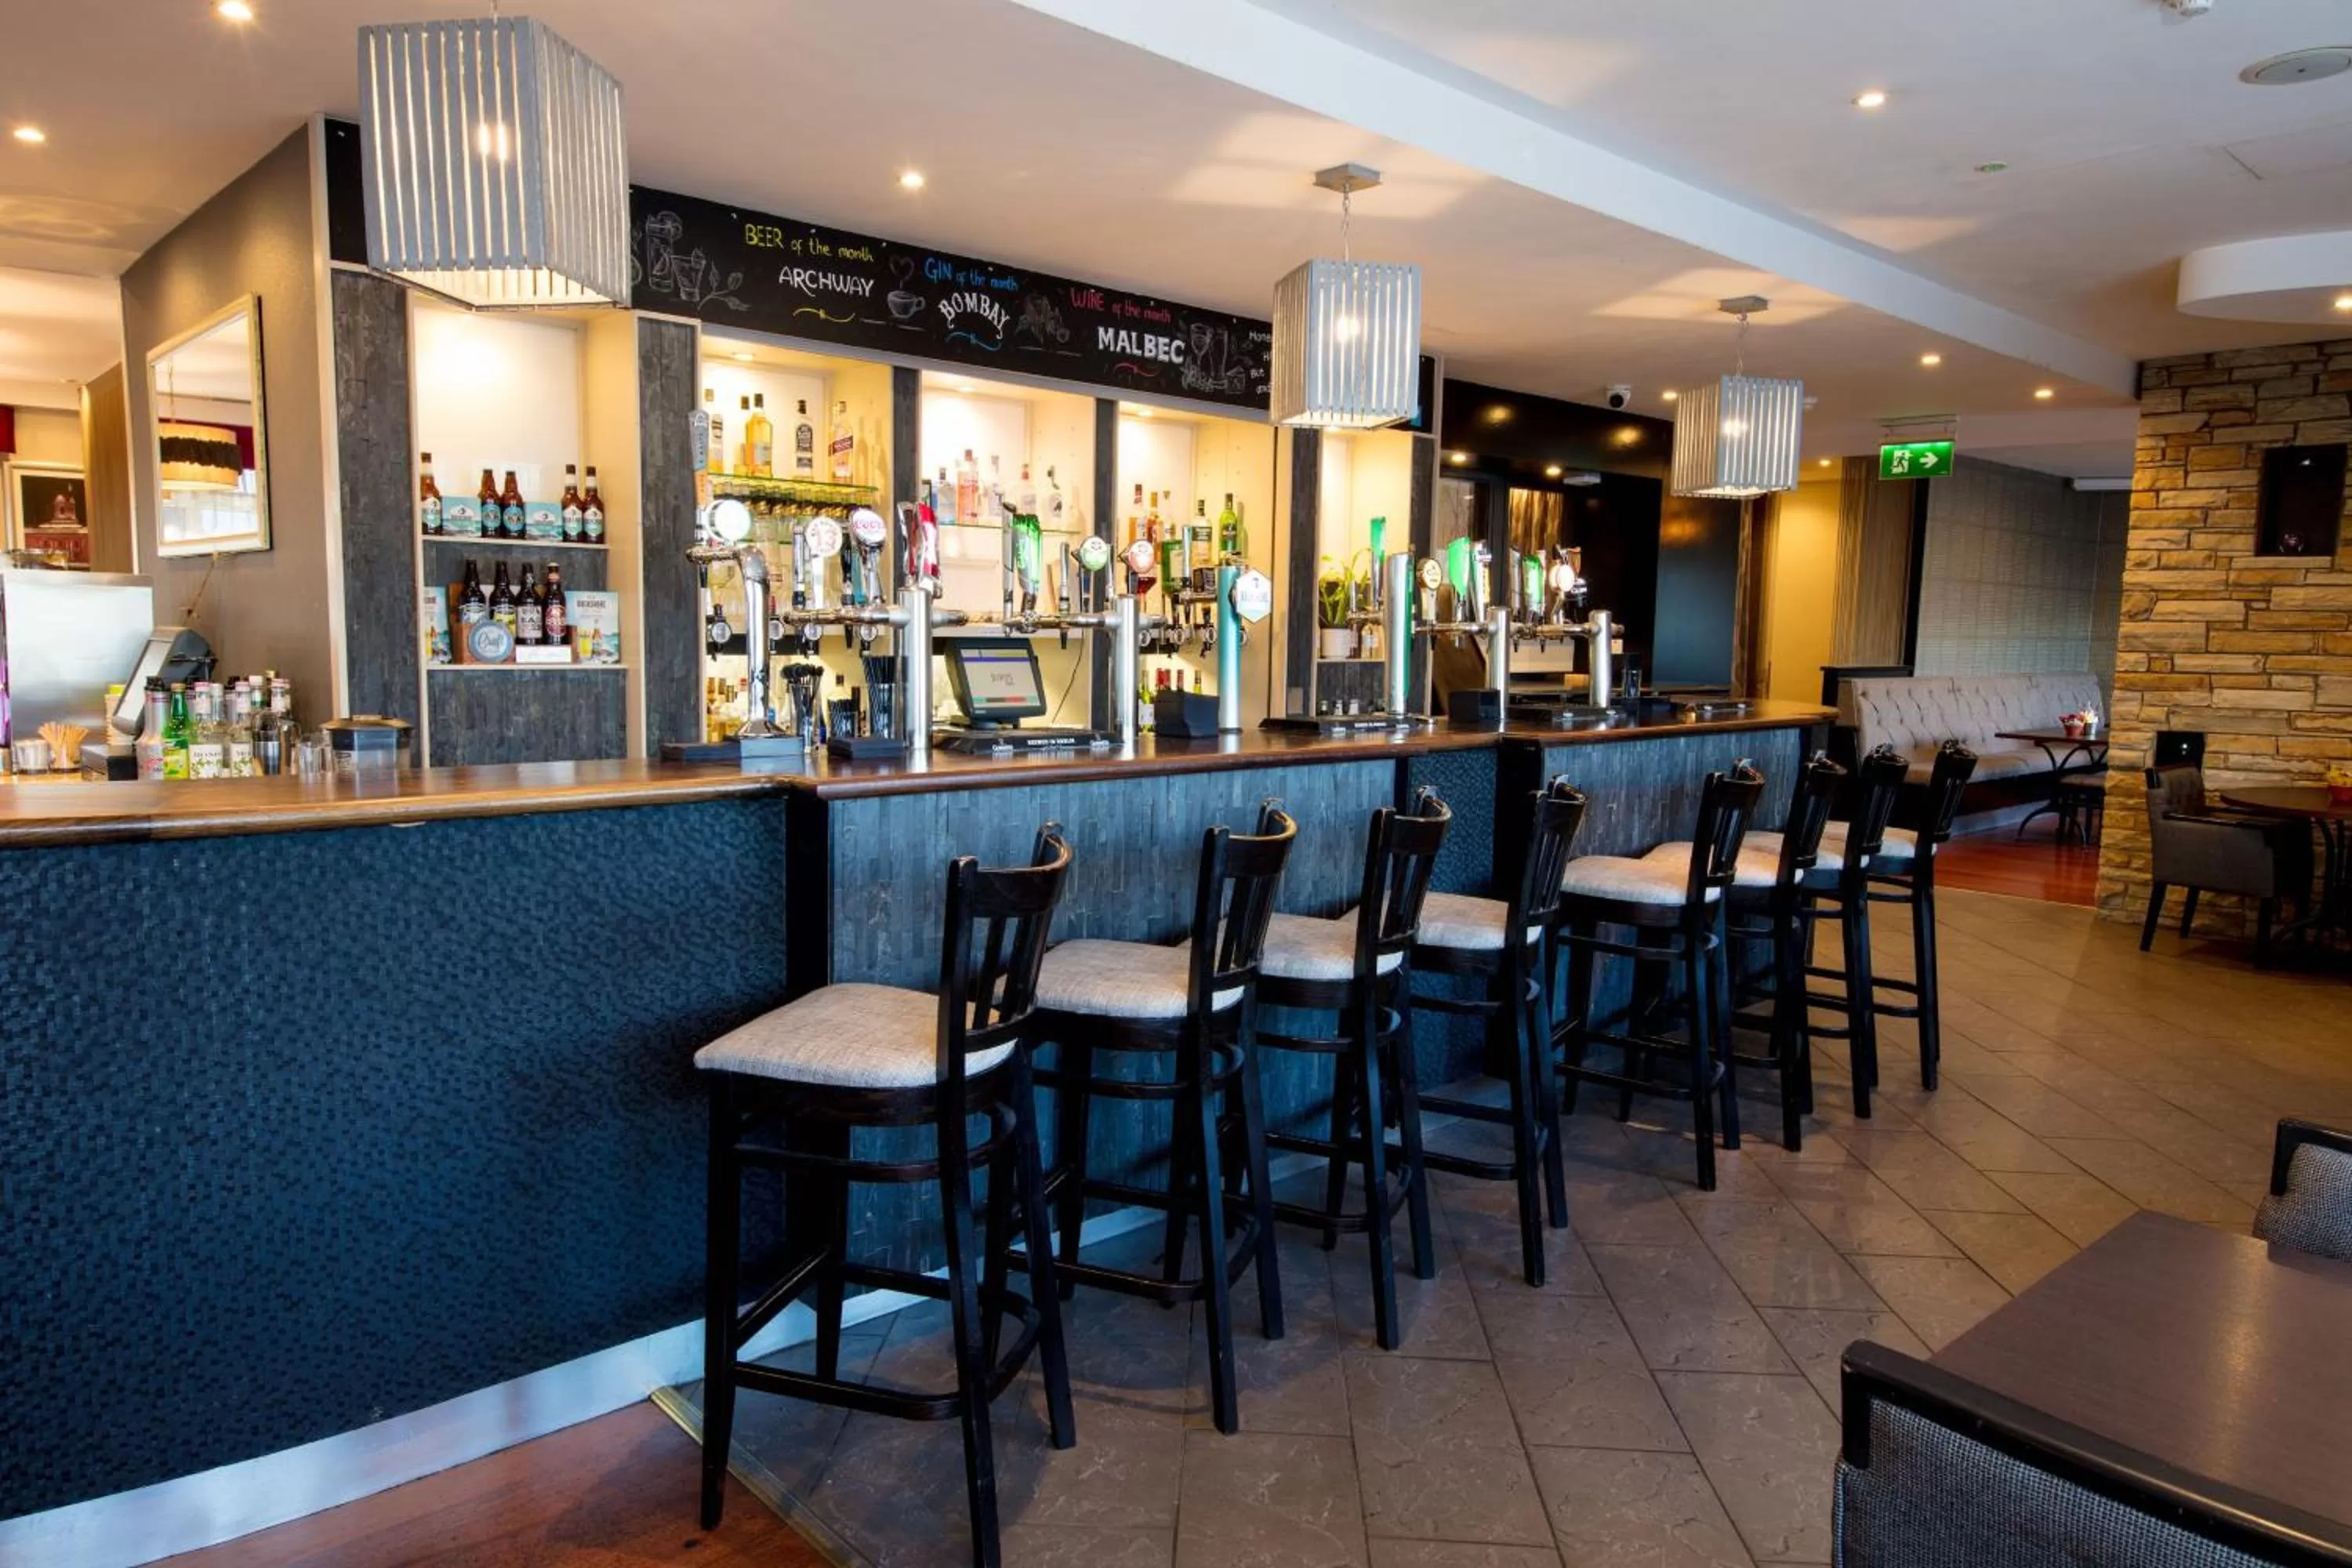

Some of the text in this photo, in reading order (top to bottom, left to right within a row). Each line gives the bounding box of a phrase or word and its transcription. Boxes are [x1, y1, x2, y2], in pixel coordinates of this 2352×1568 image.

[746, 223, 874, 263] BEER of the month
[779, 265, 875, 298] ARCHWAY
[925, 257, 952, 283] GIN
[937, 292, 1011, 339] BOMBAY
[1098, 325, 1185, 365] MALBEC
